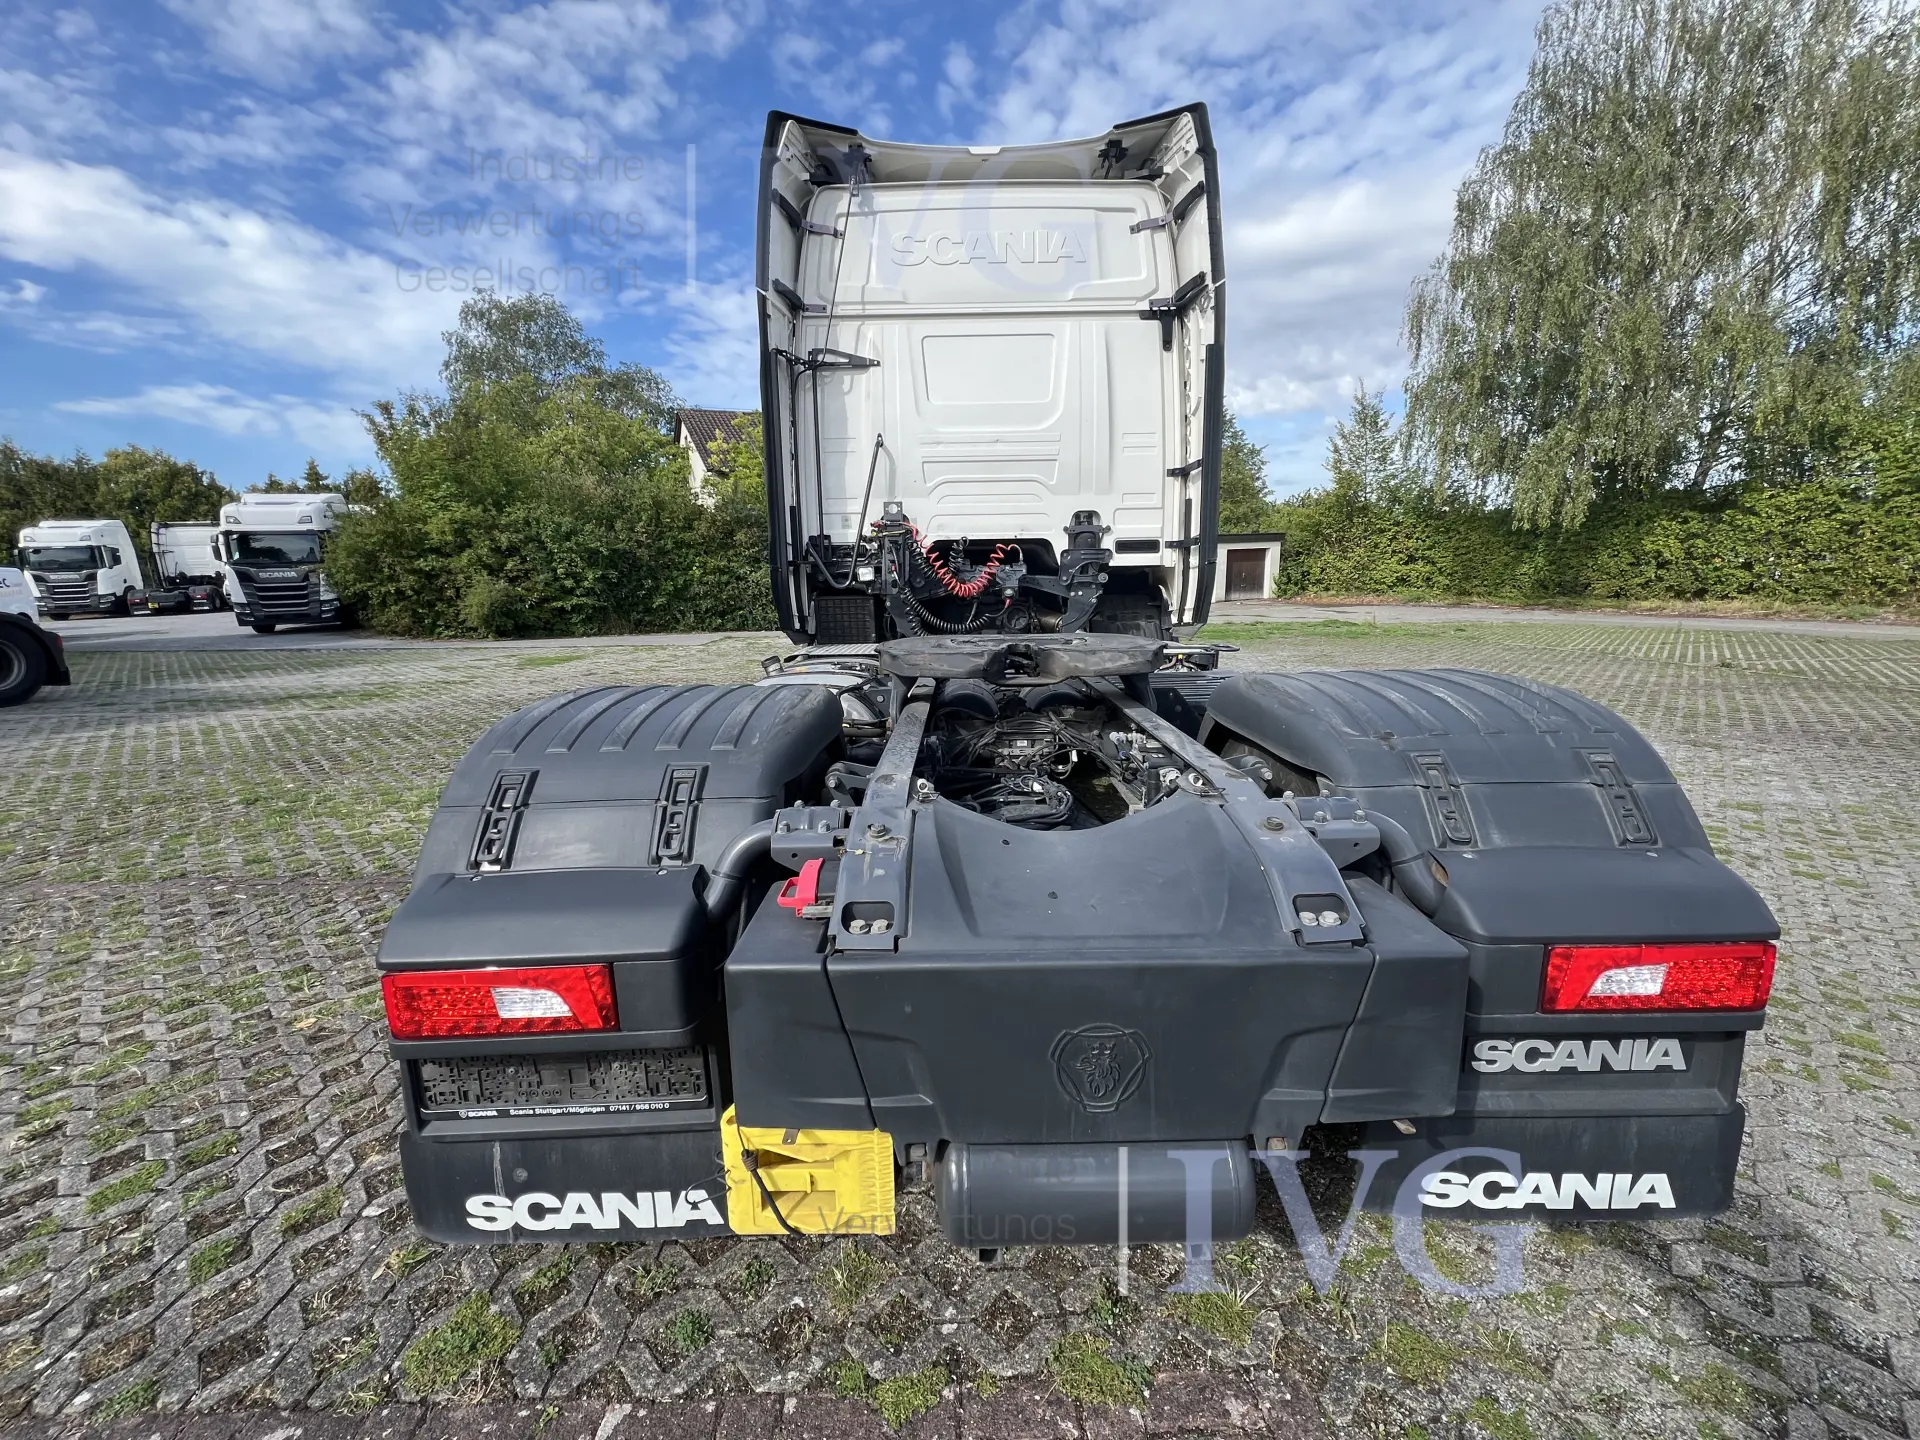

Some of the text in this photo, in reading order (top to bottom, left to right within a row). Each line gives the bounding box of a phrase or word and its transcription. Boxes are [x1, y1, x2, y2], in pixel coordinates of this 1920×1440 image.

[890, 228, 1087, 267] SCANIA
[258, 571, 298, 579] SCANIA
[1471, 1038, 1687, 1073] SCANIA
[509, 1108, 534, 1116] Scania
[1418, 1171, 1677, 1210] SCANIA
[464, 1189, 724, 1231] SCANIA
